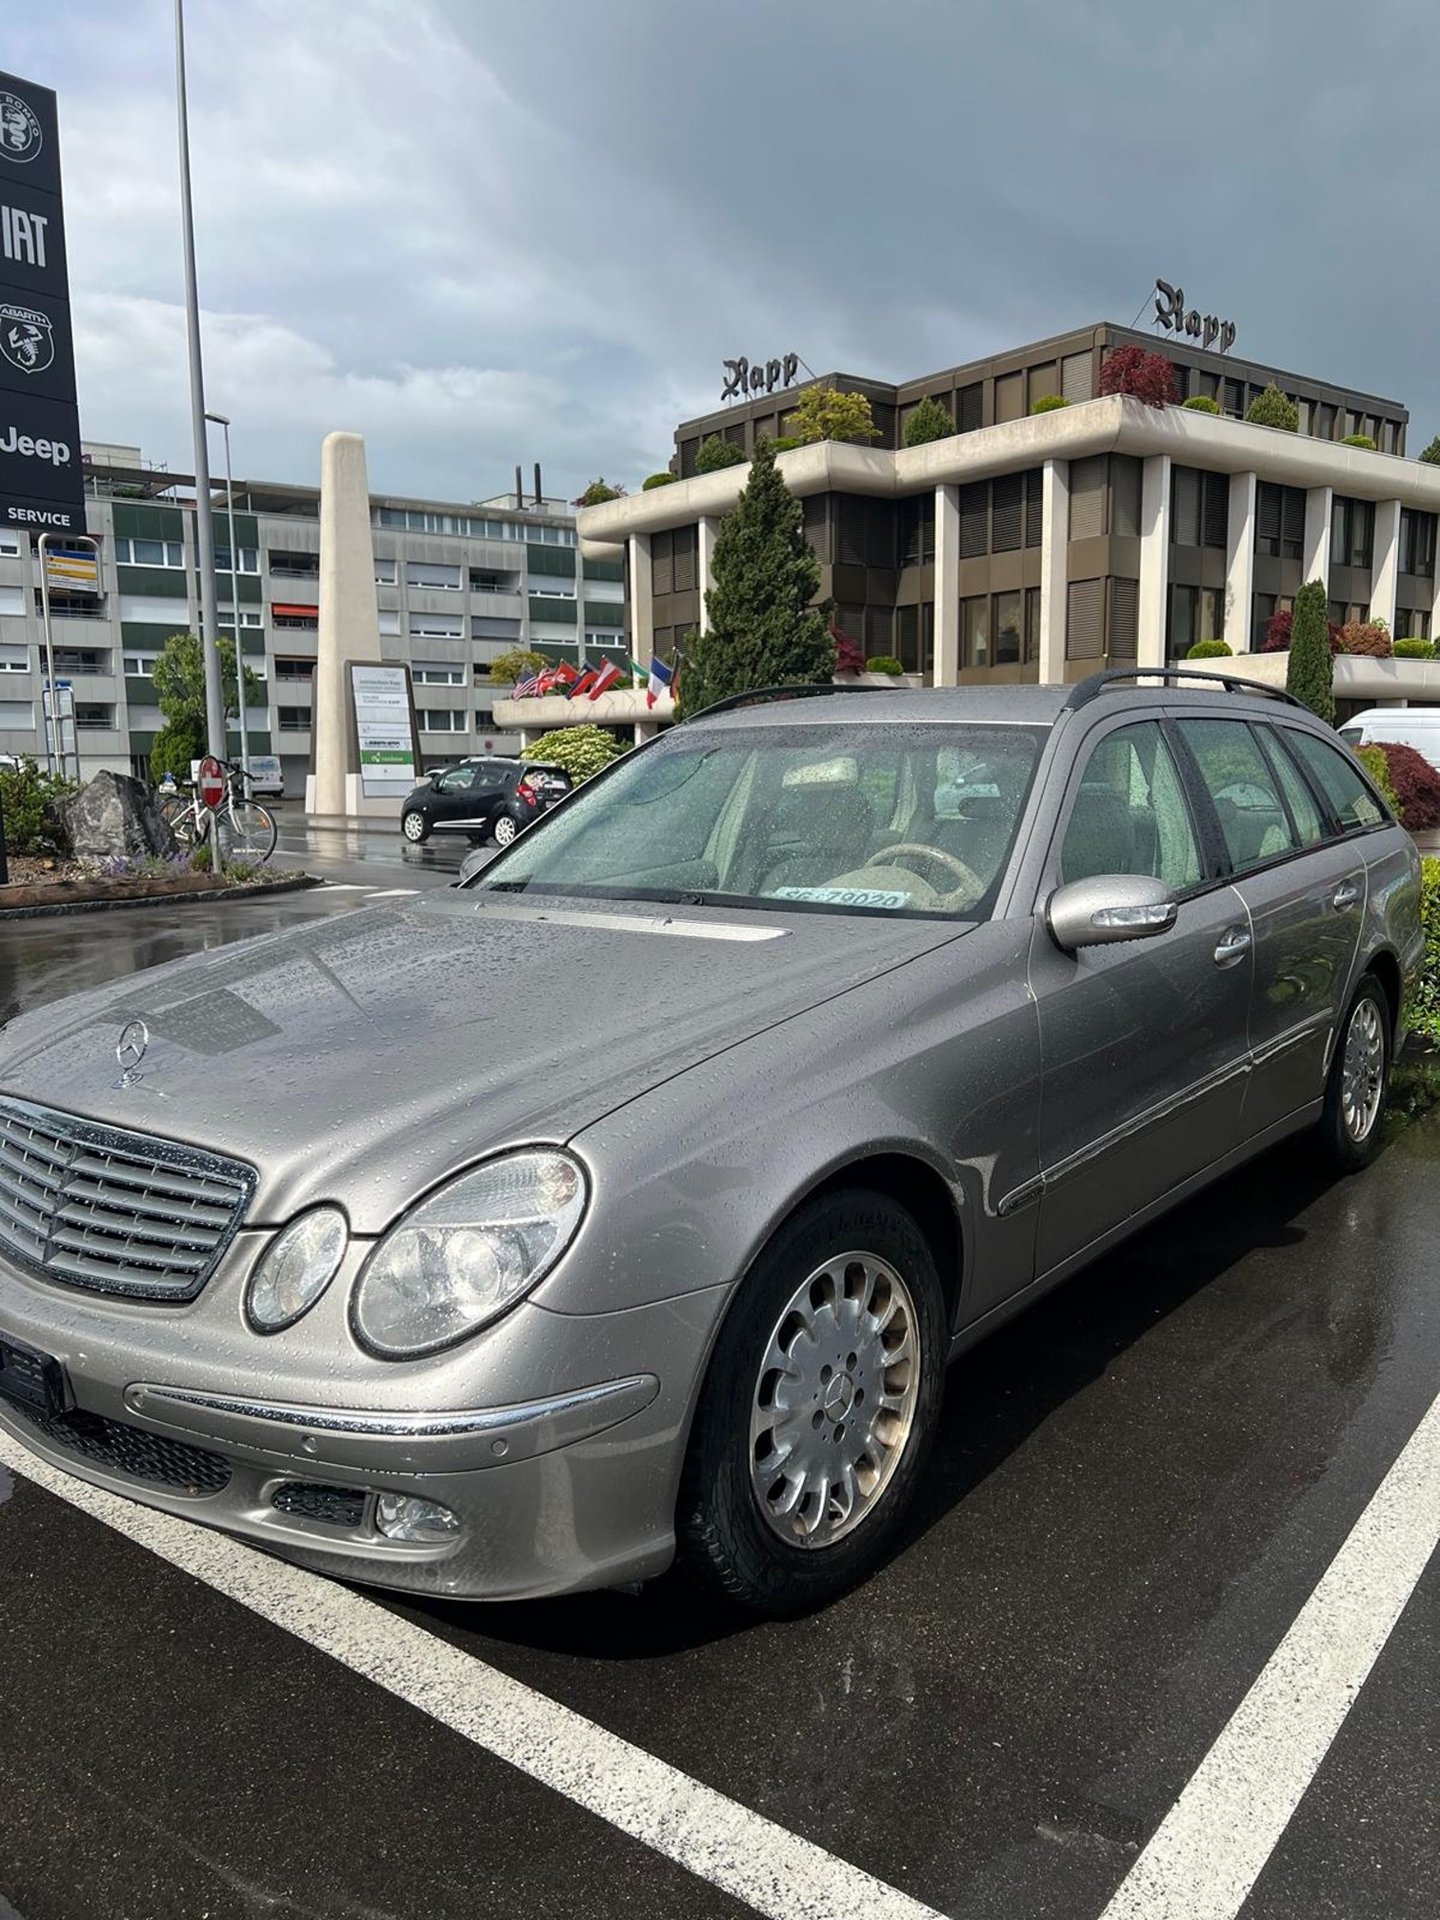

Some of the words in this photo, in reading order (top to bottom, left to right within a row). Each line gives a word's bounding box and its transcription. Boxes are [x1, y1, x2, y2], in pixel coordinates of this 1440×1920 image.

[5, 95, 39, 137] ROMEO
[0, 205, 48, 267] IAT
[1, 307, 46, 325] ABARTH
[1152, 279, 1236, 354] Rapp
[721, 353, 798, 400] Rapp
[0, 426, 70, 466] Jeep
[8, 507, 71, 526] SERVICE
